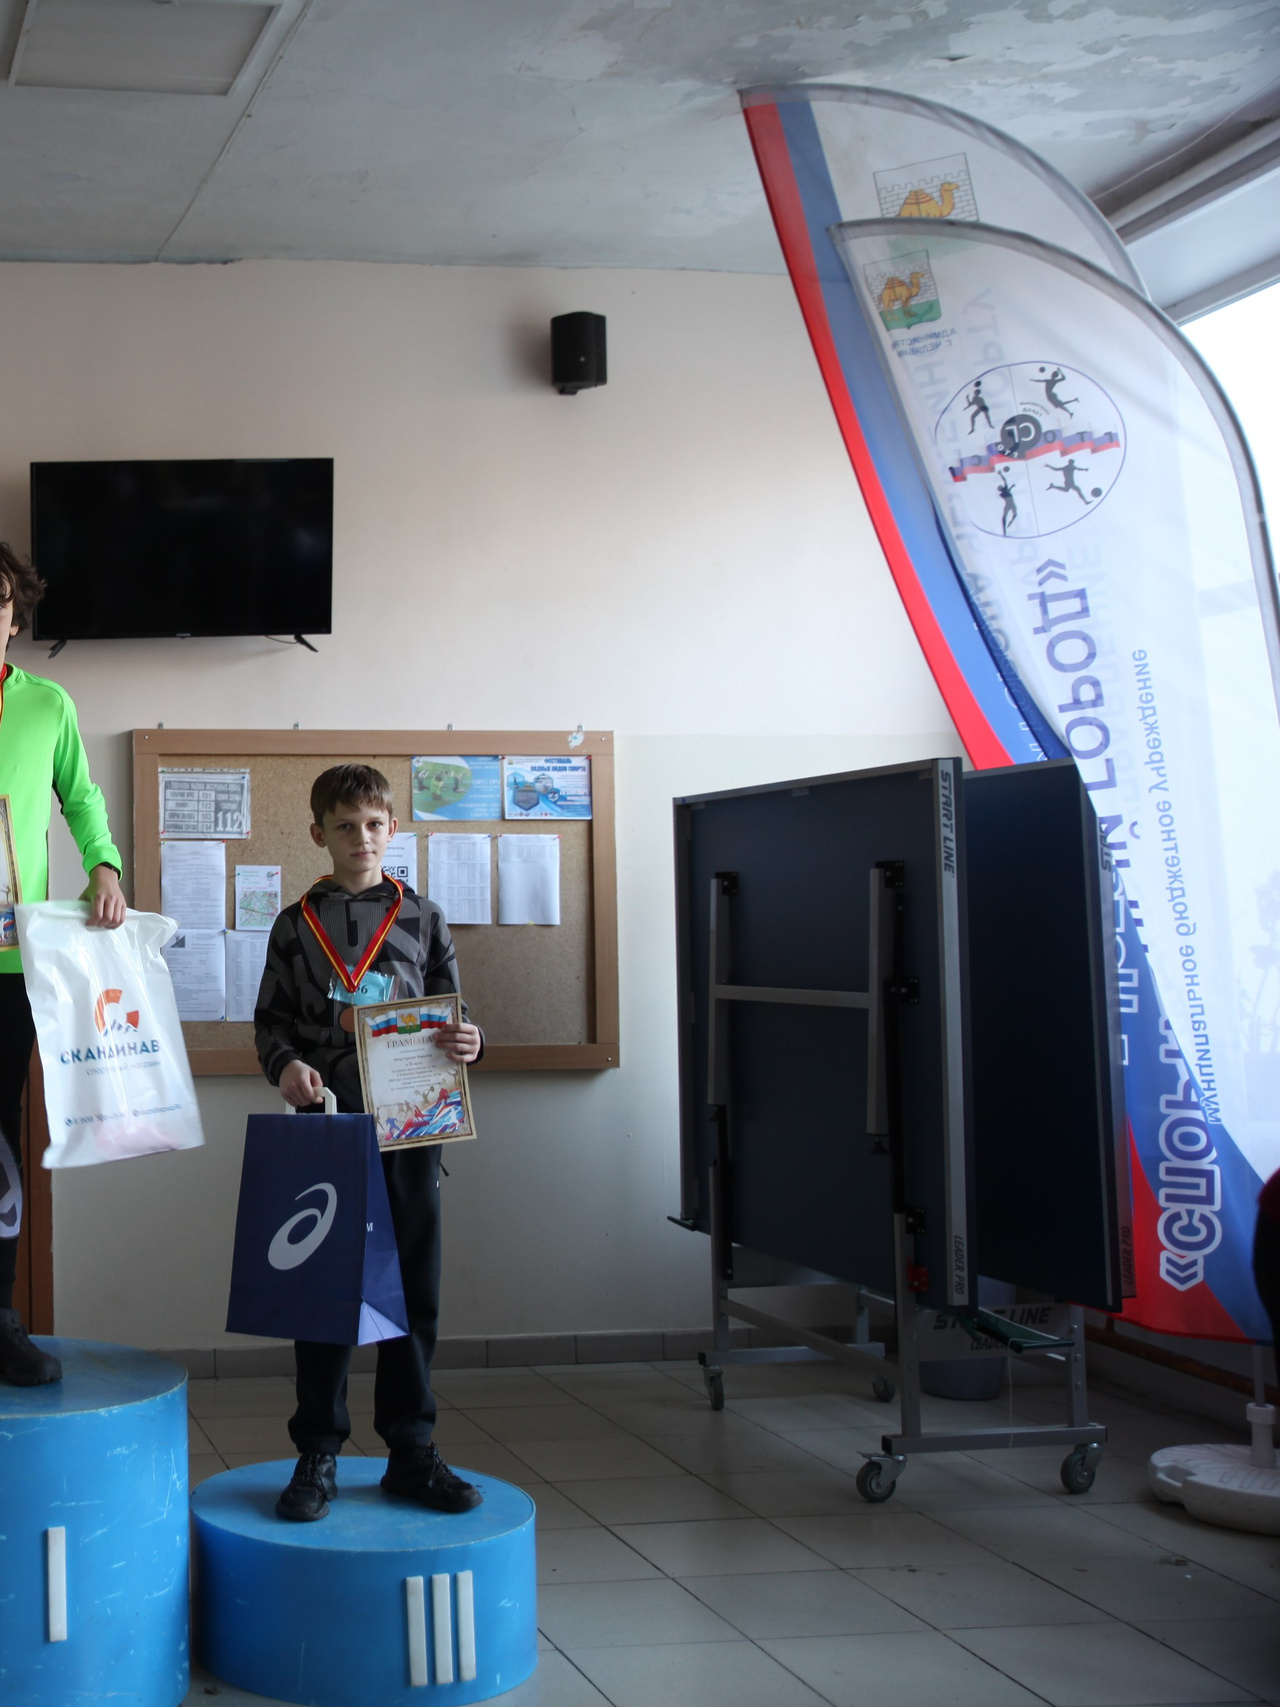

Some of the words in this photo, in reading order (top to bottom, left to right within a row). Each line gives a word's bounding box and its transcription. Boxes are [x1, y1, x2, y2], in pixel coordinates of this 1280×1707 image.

[940, 770, 954, 833] START
[216, 811, 242, 831] 112
[942, 836, 956, 874] LINE
[60, 1039, 160, 1064] СКАНДИНАВ
[386, 1036, 433, 1048] ГРАМОТА
[954, 1235, 965, 1274] LEADER
[954, 1274, 965, 1295] PRO
[1010, 1307, 1052, 1325] LINE
[47, 1526, 66, 1642] I
[405, 1569, 477, 1686] III
